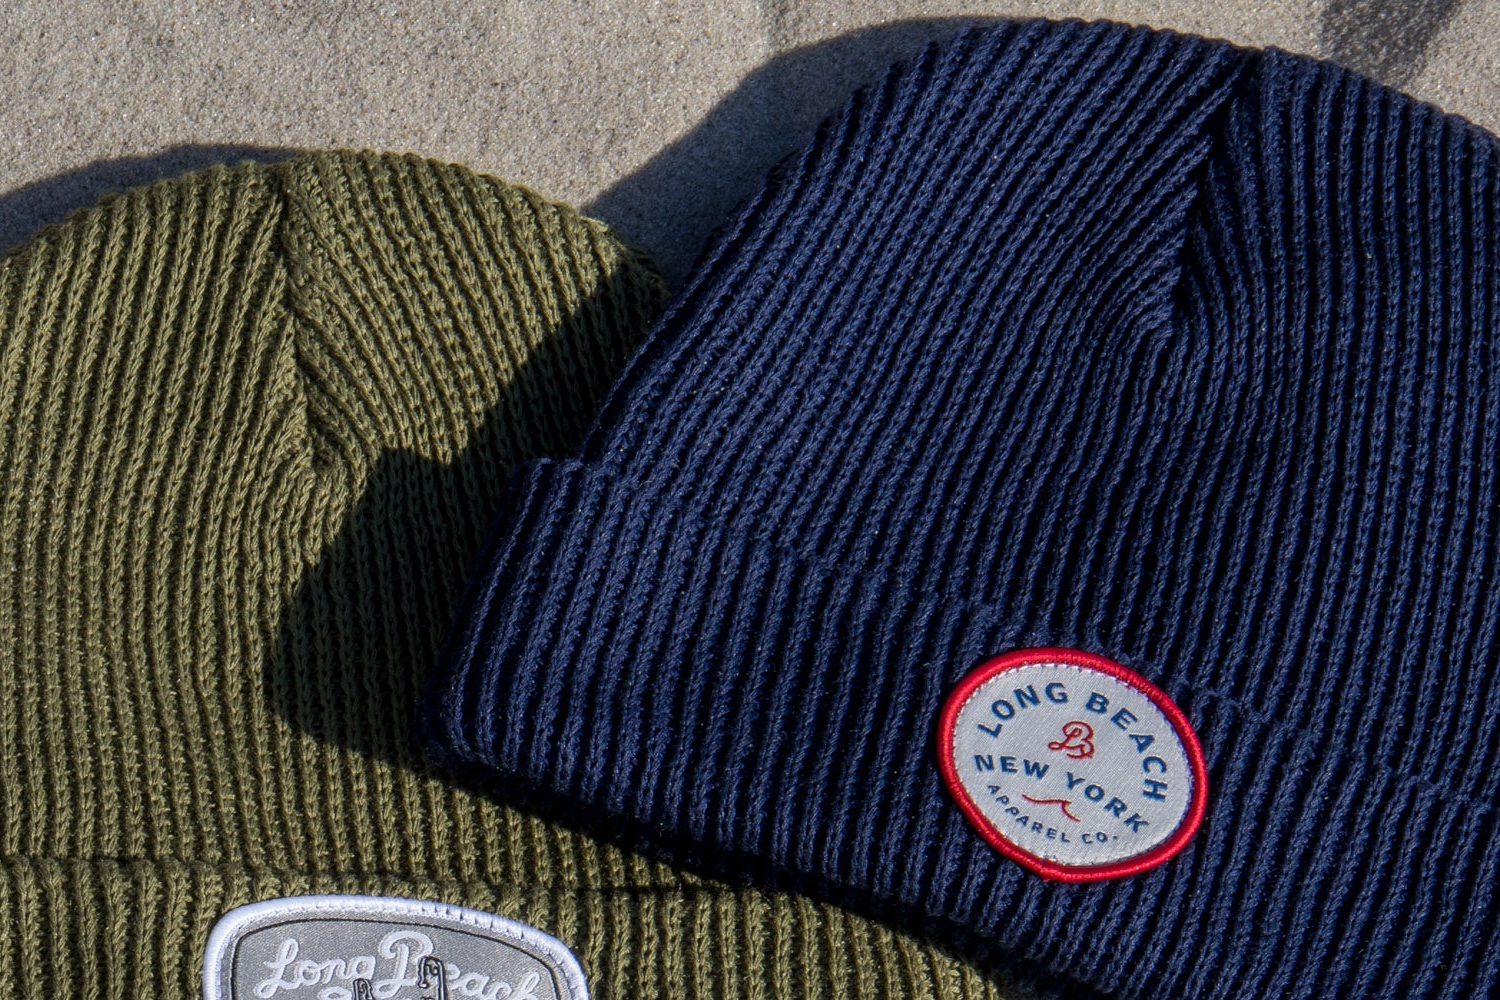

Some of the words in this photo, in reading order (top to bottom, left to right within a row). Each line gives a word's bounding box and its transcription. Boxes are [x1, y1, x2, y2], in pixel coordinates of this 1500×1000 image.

[976, 682, 1069, 739] LONG
[1084, 691, 1169, 803] BEACH
[973, 753, 1050, 780] NEW
[1064, 771, 1150, 834] YORK
[986, 784, 1071, 844] APPAREL
